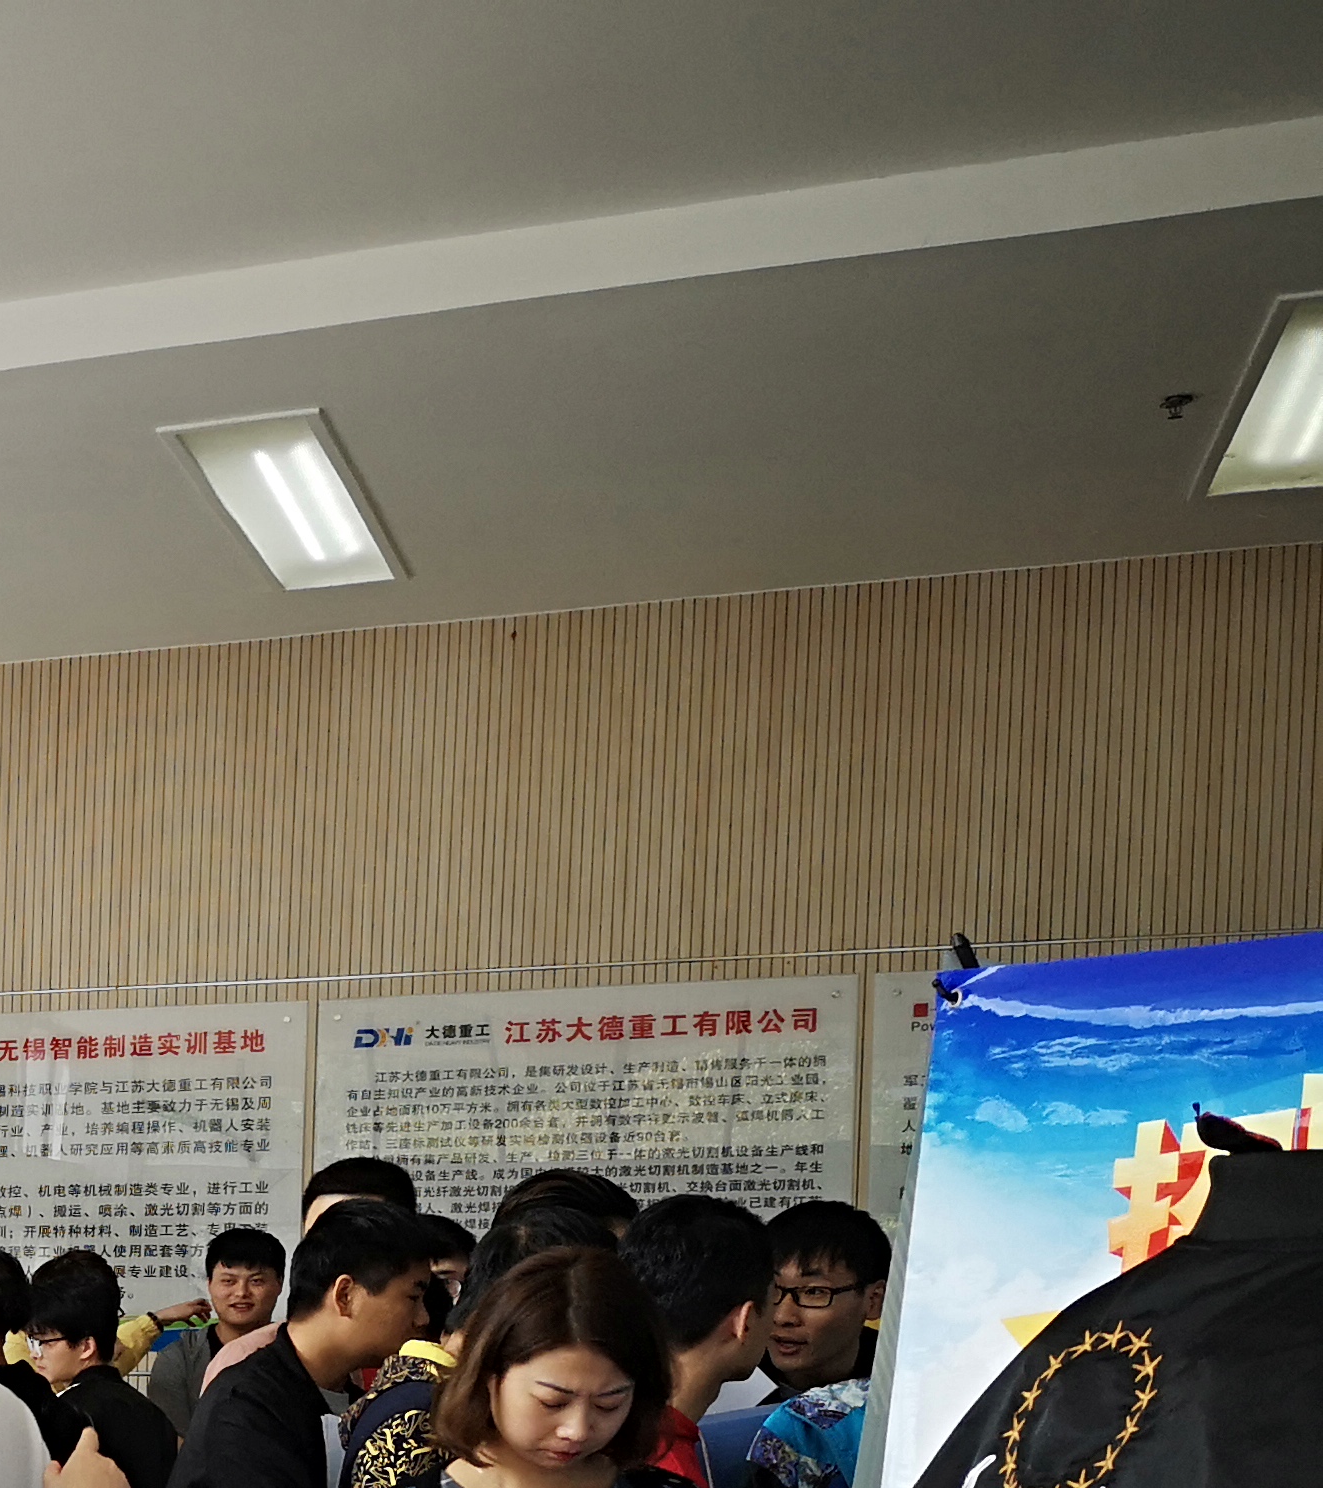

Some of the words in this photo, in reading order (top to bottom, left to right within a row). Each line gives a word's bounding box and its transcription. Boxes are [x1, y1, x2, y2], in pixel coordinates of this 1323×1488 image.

[425, 1023, 491, 1040] 大德重工
[504, 1007, 818, 1045] 江苏大德重工有限公司
